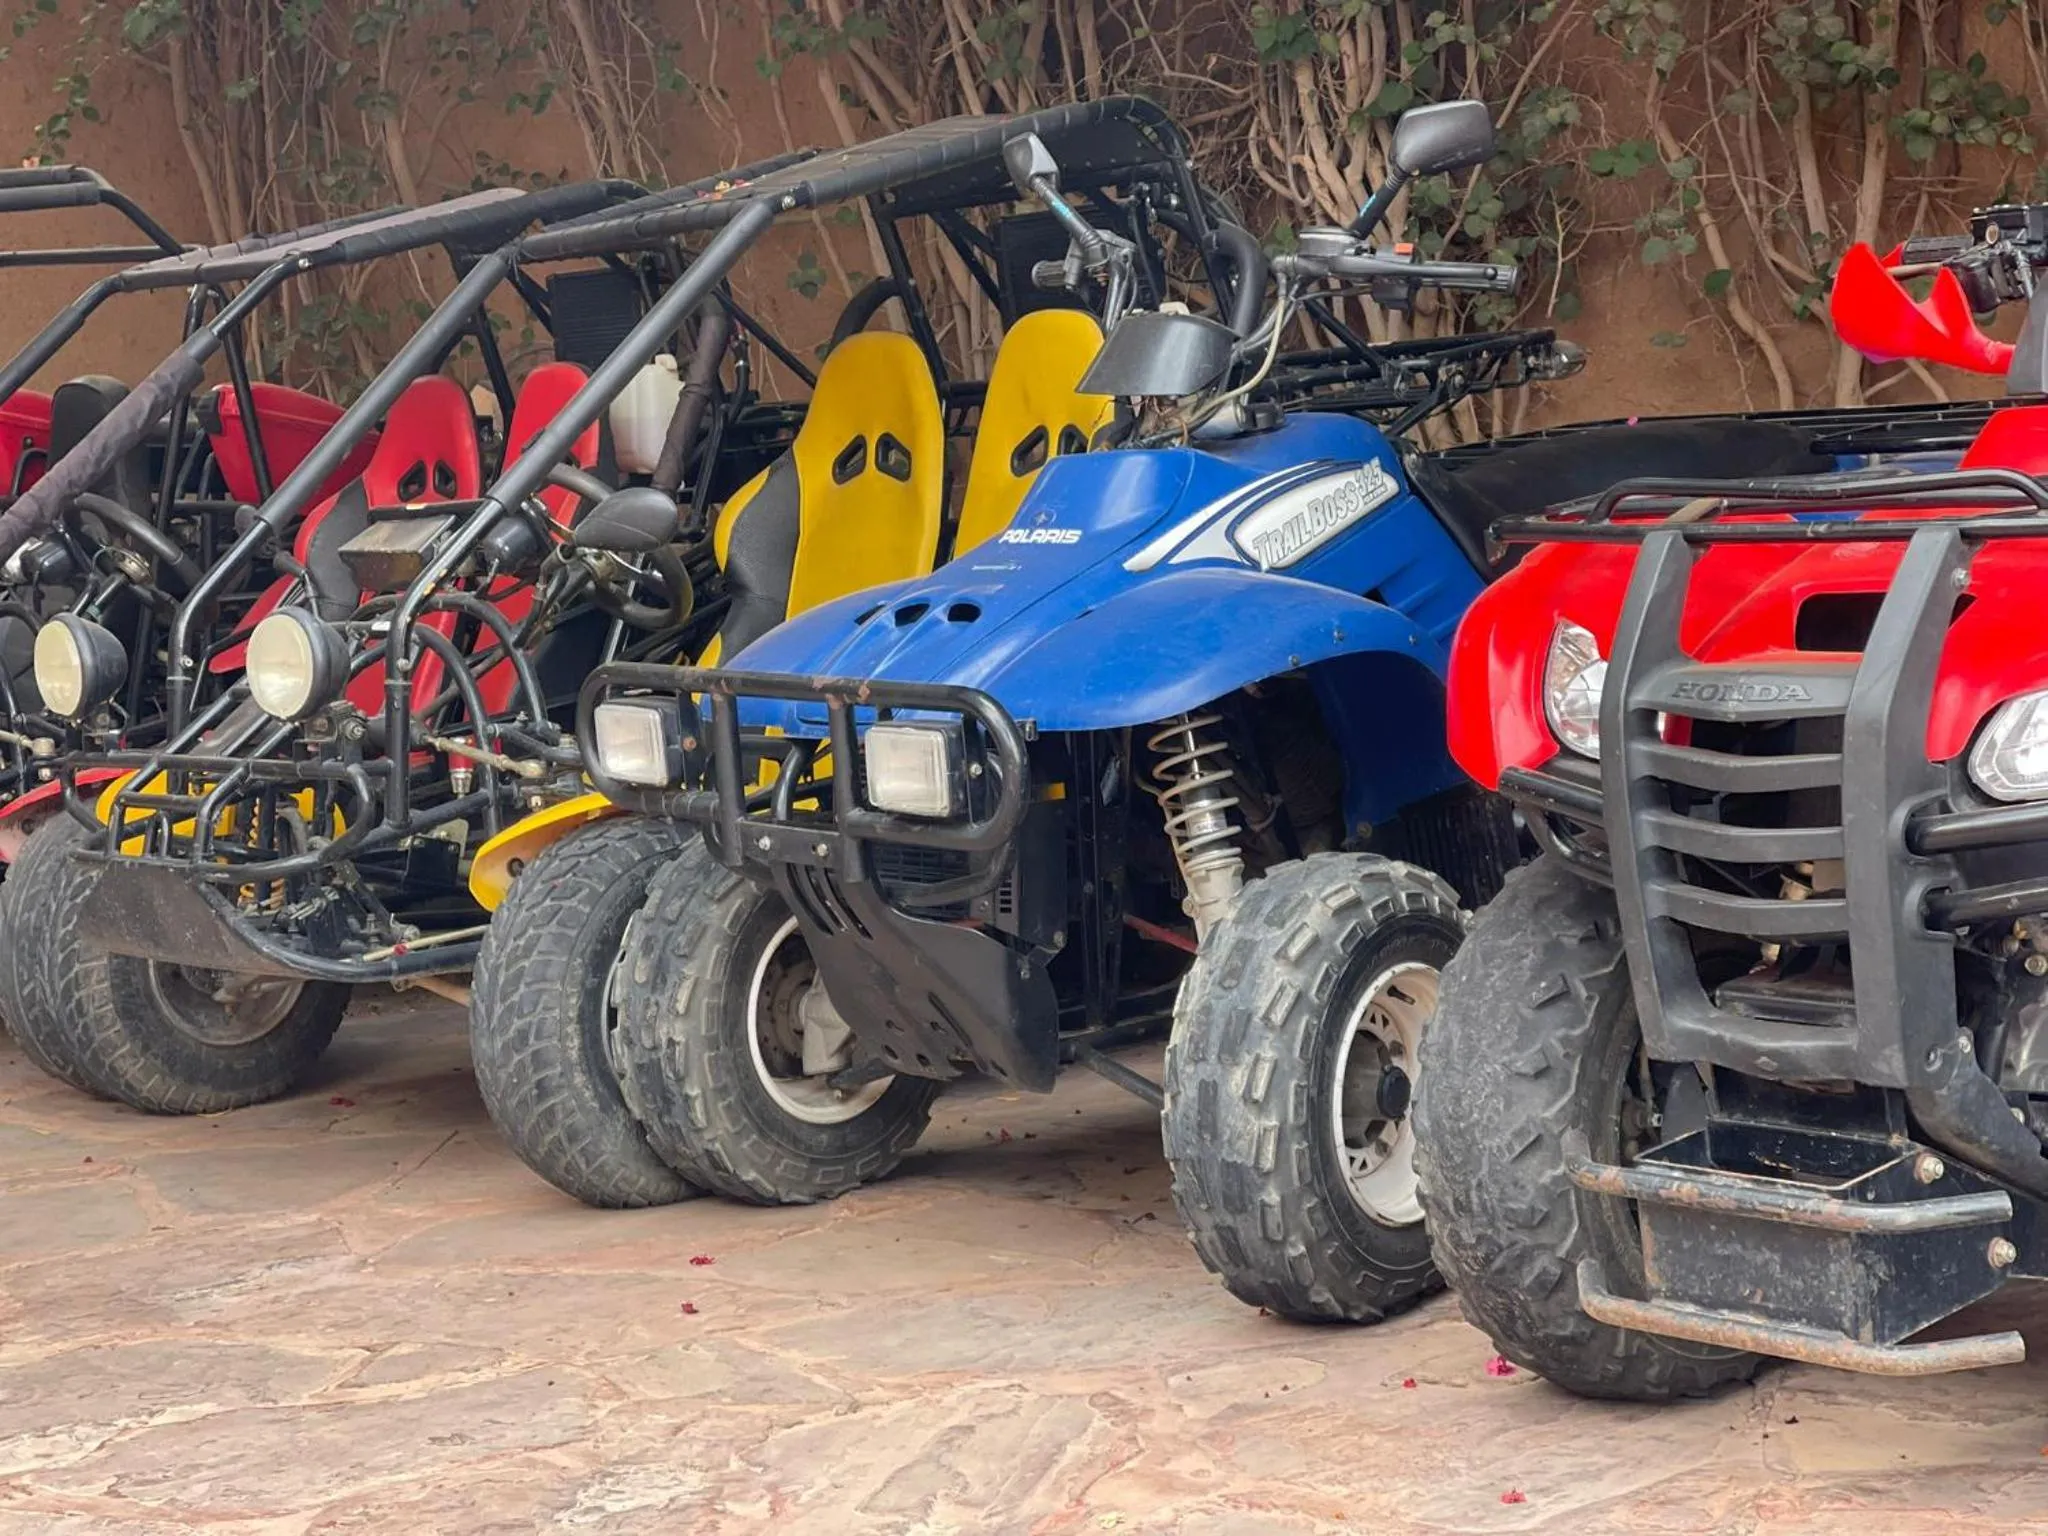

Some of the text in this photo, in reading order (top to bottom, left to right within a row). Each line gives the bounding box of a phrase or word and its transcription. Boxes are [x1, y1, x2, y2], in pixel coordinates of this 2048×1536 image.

[1252, 456, 1384, 573] TRAIL BOSS 325
[998, 528, 1082, 544] POLARIS
[1671, 681, 1812, 702] HONDA
